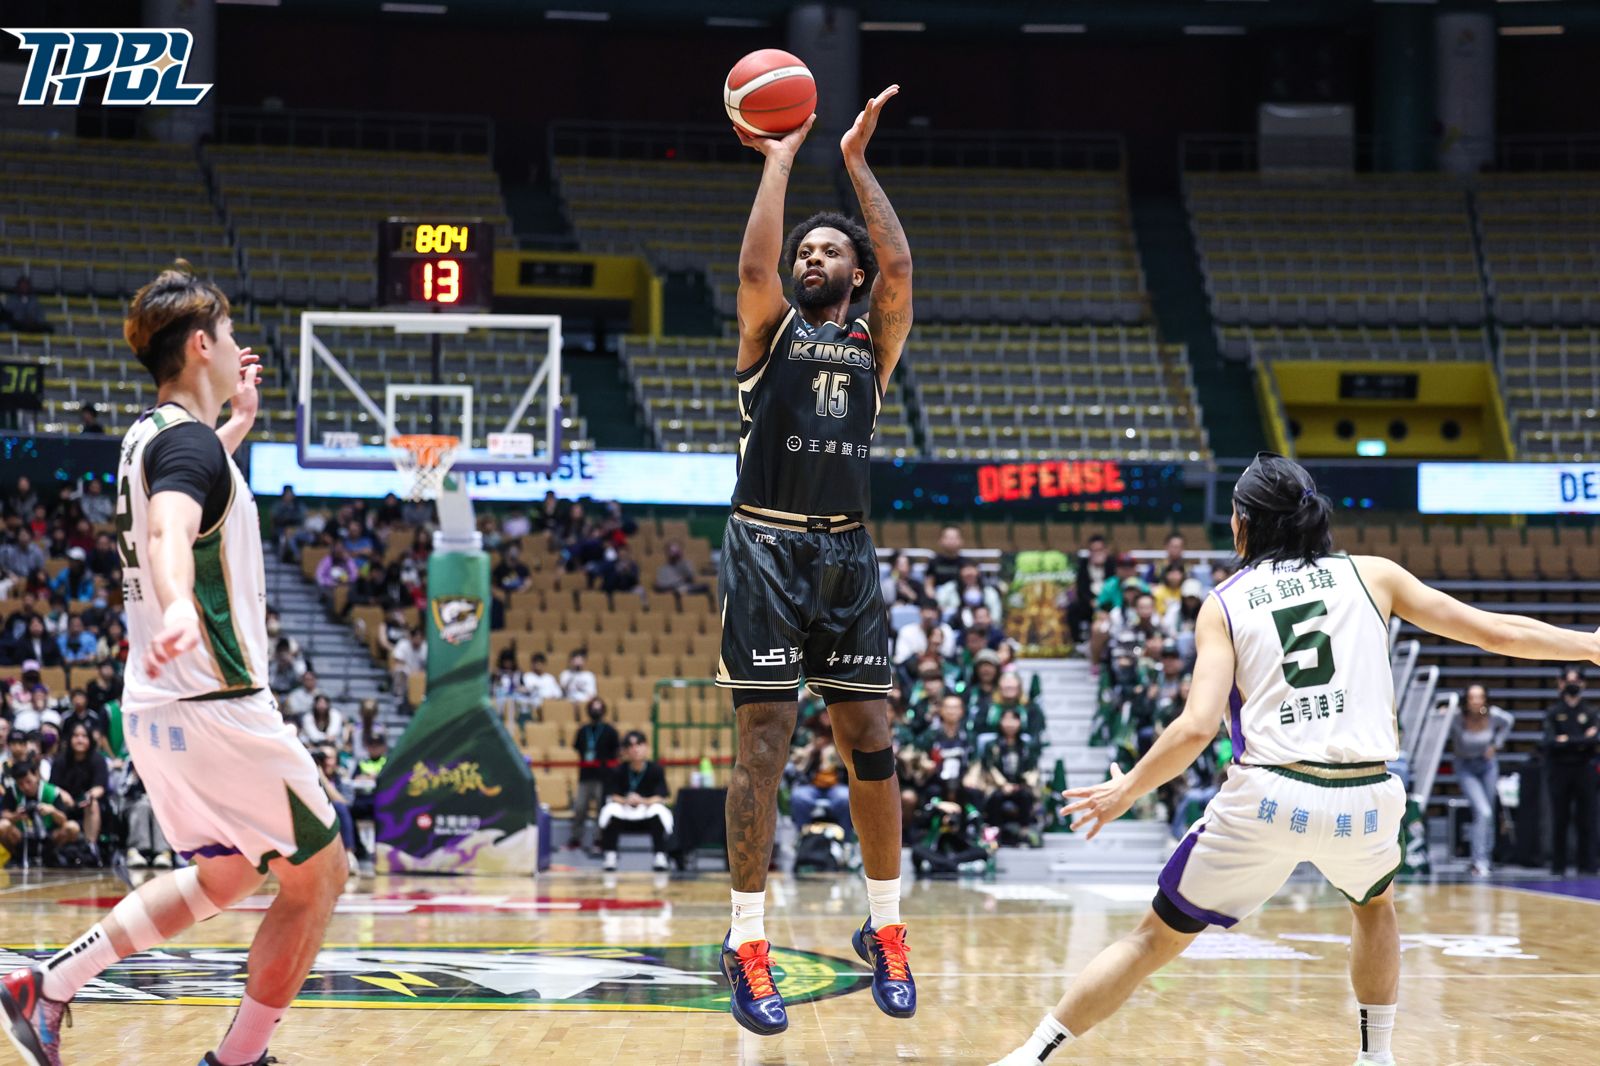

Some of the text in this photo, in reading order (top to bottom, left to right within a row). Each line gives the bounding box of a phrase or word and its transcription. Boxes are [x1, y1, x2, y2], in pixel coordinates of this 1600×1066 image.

[415, 225, 468, 253] 8:04
[423, 260, 460, 303] 13
[788, 340, 872, 370] KINGS
[812, 371, 850, 418] 15
[808, 439, 868, 459] 王道銀行
[977, 461, 1125, 503] DEFENSE
[1560, 471, 1600, 502] DE
[1245, 568, 1337, 609] 高錦瑋
[1271, 600, 1336, 689] 5
